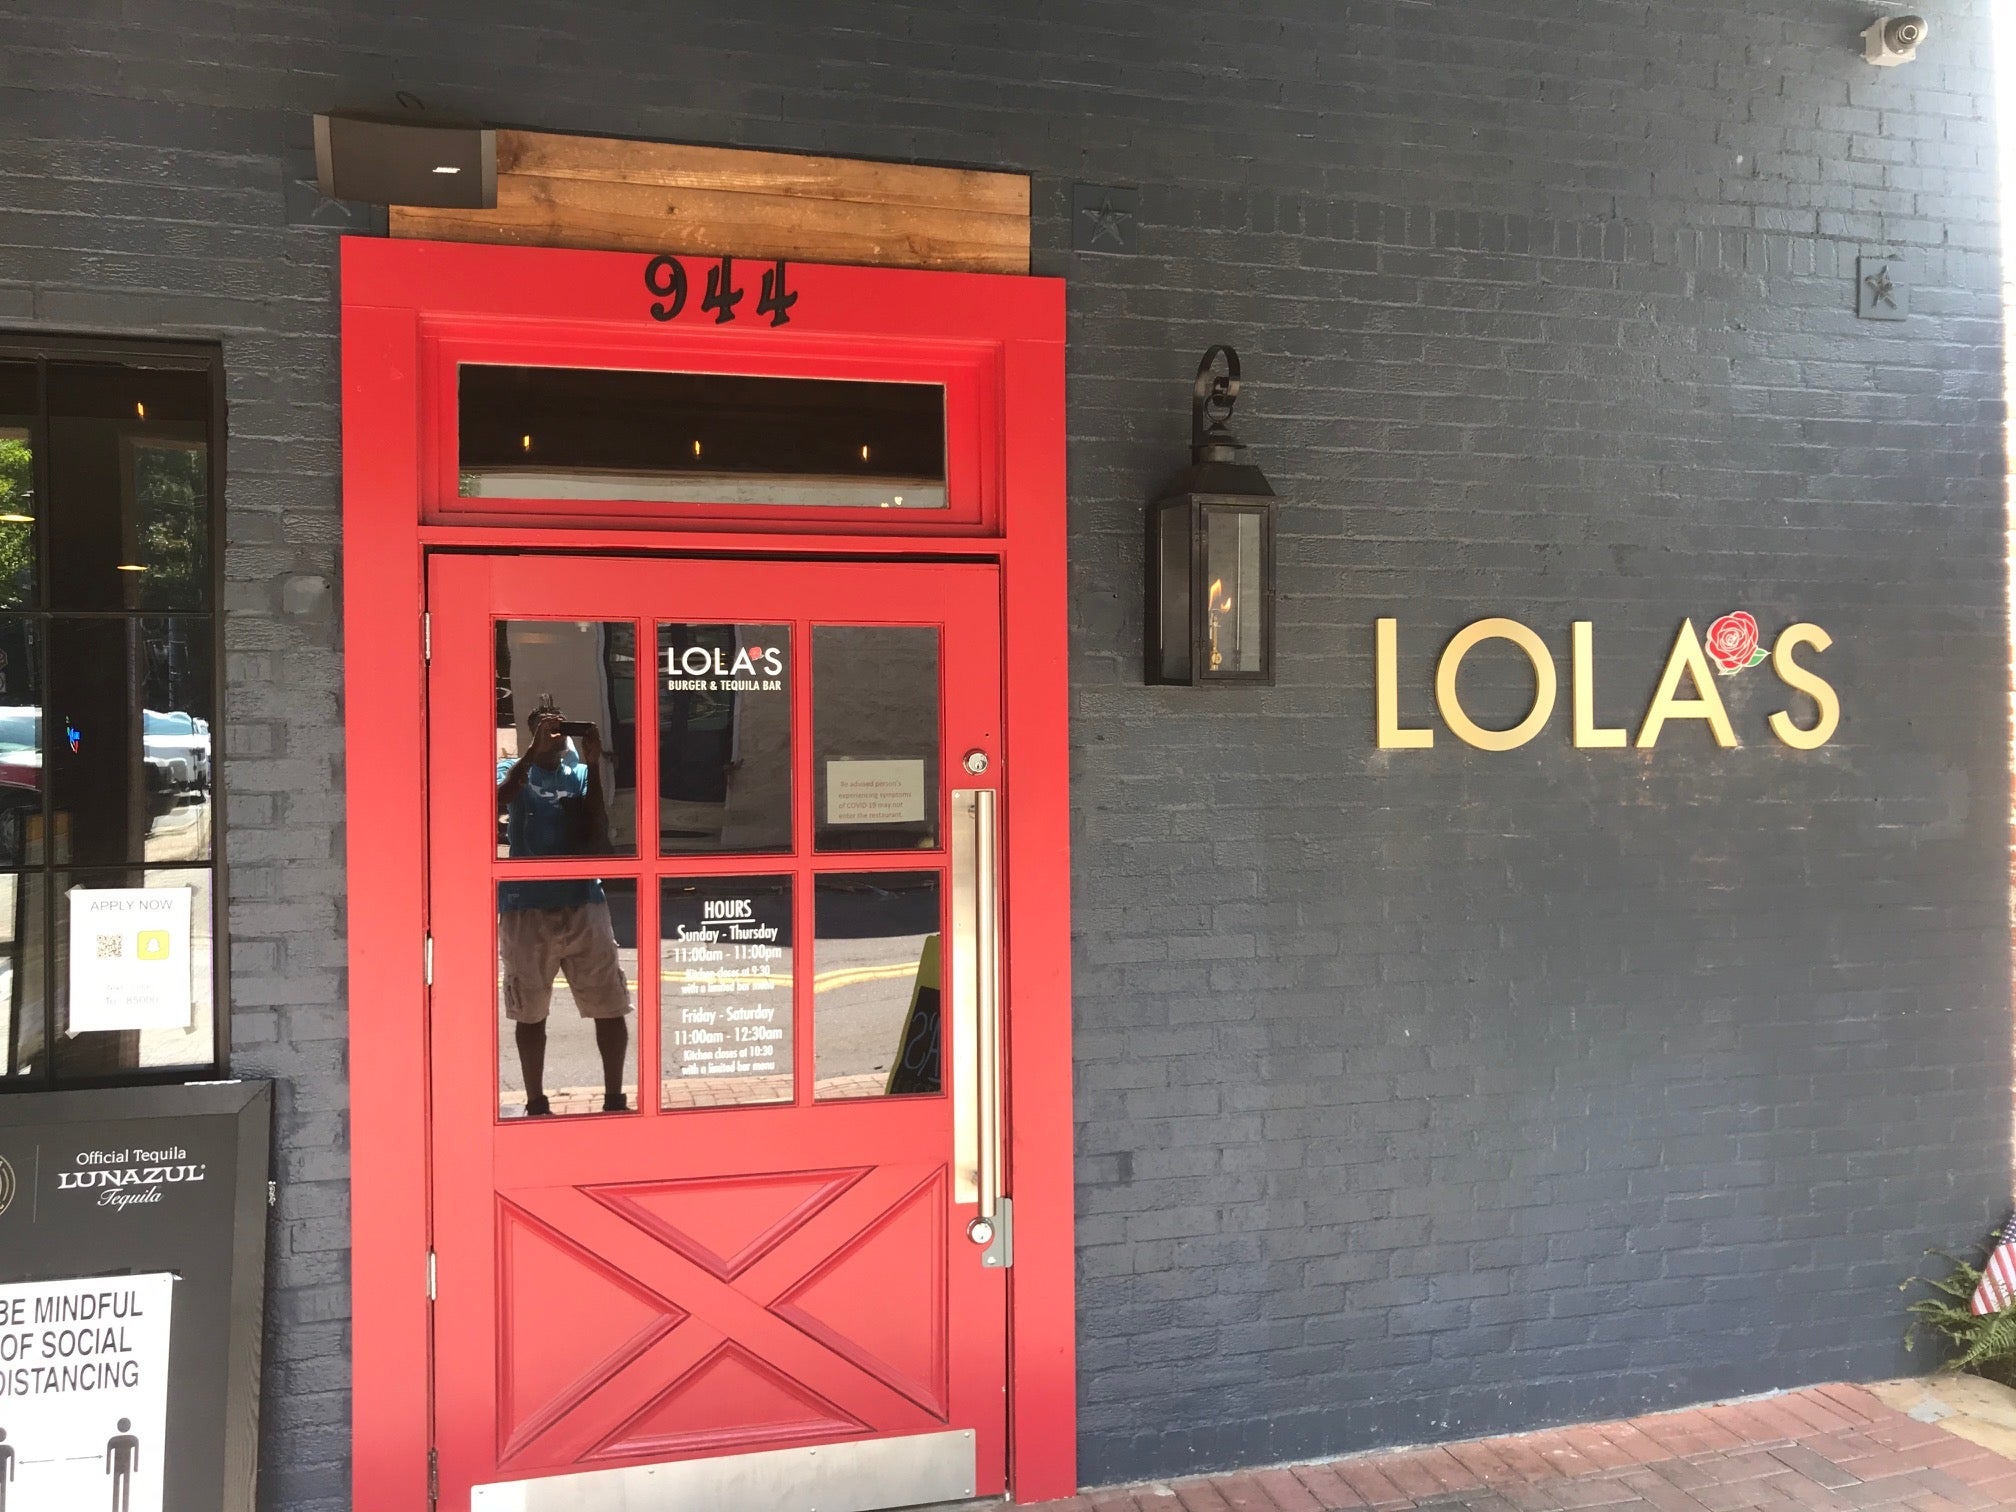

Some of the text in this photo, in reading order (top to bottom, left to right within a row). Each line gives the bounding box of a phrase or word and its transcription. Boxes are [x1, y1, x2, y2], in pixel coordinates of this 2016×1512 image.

[645, 255, 798, 327] 944
[669, 680, 781, 691] BURGER & TEQUILA BAR
[90, 900, 173, 912] APPLY NOW
[704, 900, 752, 918] HOURS
[677, 924, 719, 943] Sunday
[729, 923, 778, 941] Thursday
[674, 948, 722, 962] 11:00am
[734, 944, 782, 961] 11:00pm
[682, 1008, 716, 1025] Friday
[727, 1004, 774, 1022] Saturday
[674, 1030, 723, 1045] 11:00am
[734, 1027, 782, 1042] 12:30am
[684, 1045, 773, 1061] Kitchen closes at 10:30
[682, 1062, 699, 1075] with
[701, 1066, 706, 1074] a
[708, 1060, 735, 1073] limited
[737, 1060, 750, 1071] bar
[76, 1146, 186, 1165] Official Tequila
[97, 1186, 163, 1212] Tequila
[34, 1291, 143, 1324] MINDFUL
[0, 1327, 132, 1362] OF SOCIAL
